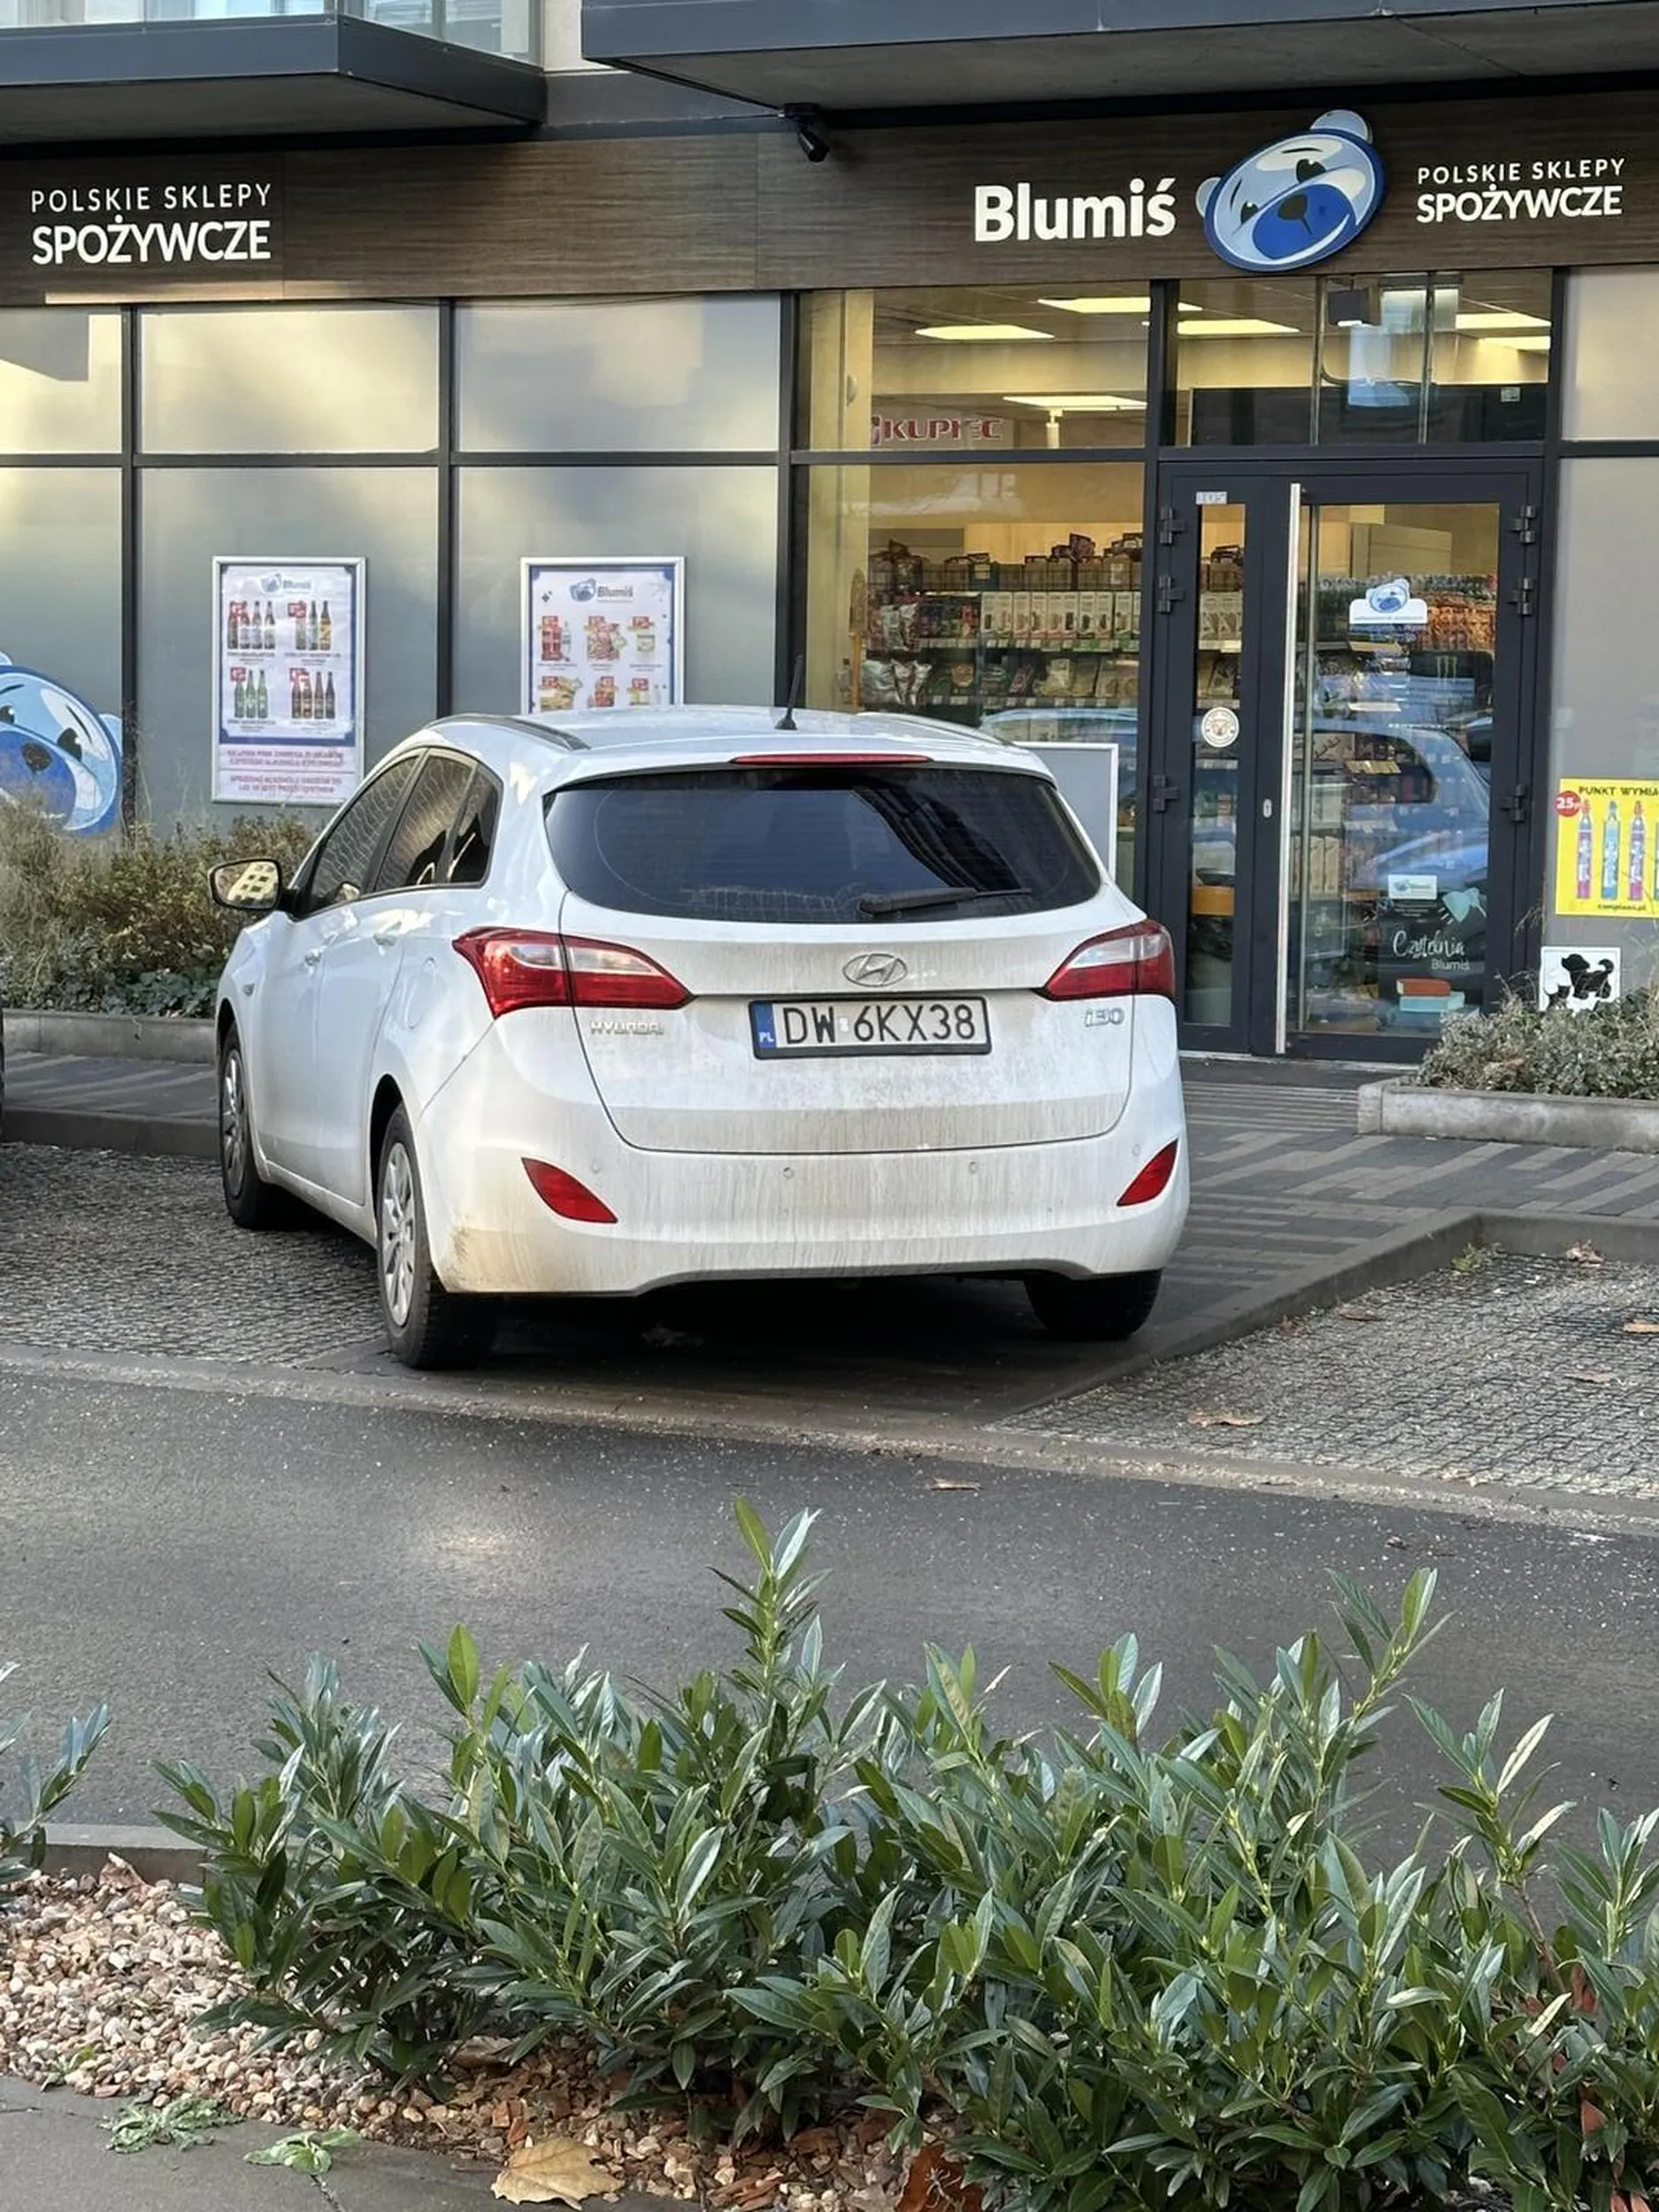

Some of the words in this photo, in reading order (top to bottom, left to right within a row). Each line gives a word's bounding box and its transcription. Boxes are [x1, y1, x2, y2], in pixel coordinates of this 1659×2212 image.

[1417, 163, 1521, 185] POLSKIE
[1532, 157, 1625, 180] SKLEPY
[31, 186, 150, 213] POLSKIE
[164, 182, 272, 211] SKLEPY
[974, 177, 1177, 242] Blumiś
[1416, 183, 1624, 223] SPOŻYWCZE
[32, 214, 272, 265] SPOŻYWCZE
[1578, 786, 1616, 795] PUNKT
[758, 1031, 774, 1042] PL
[783, 1006, 836, 1045] DW
[854, 1003, 976, 1042] 6KX38
